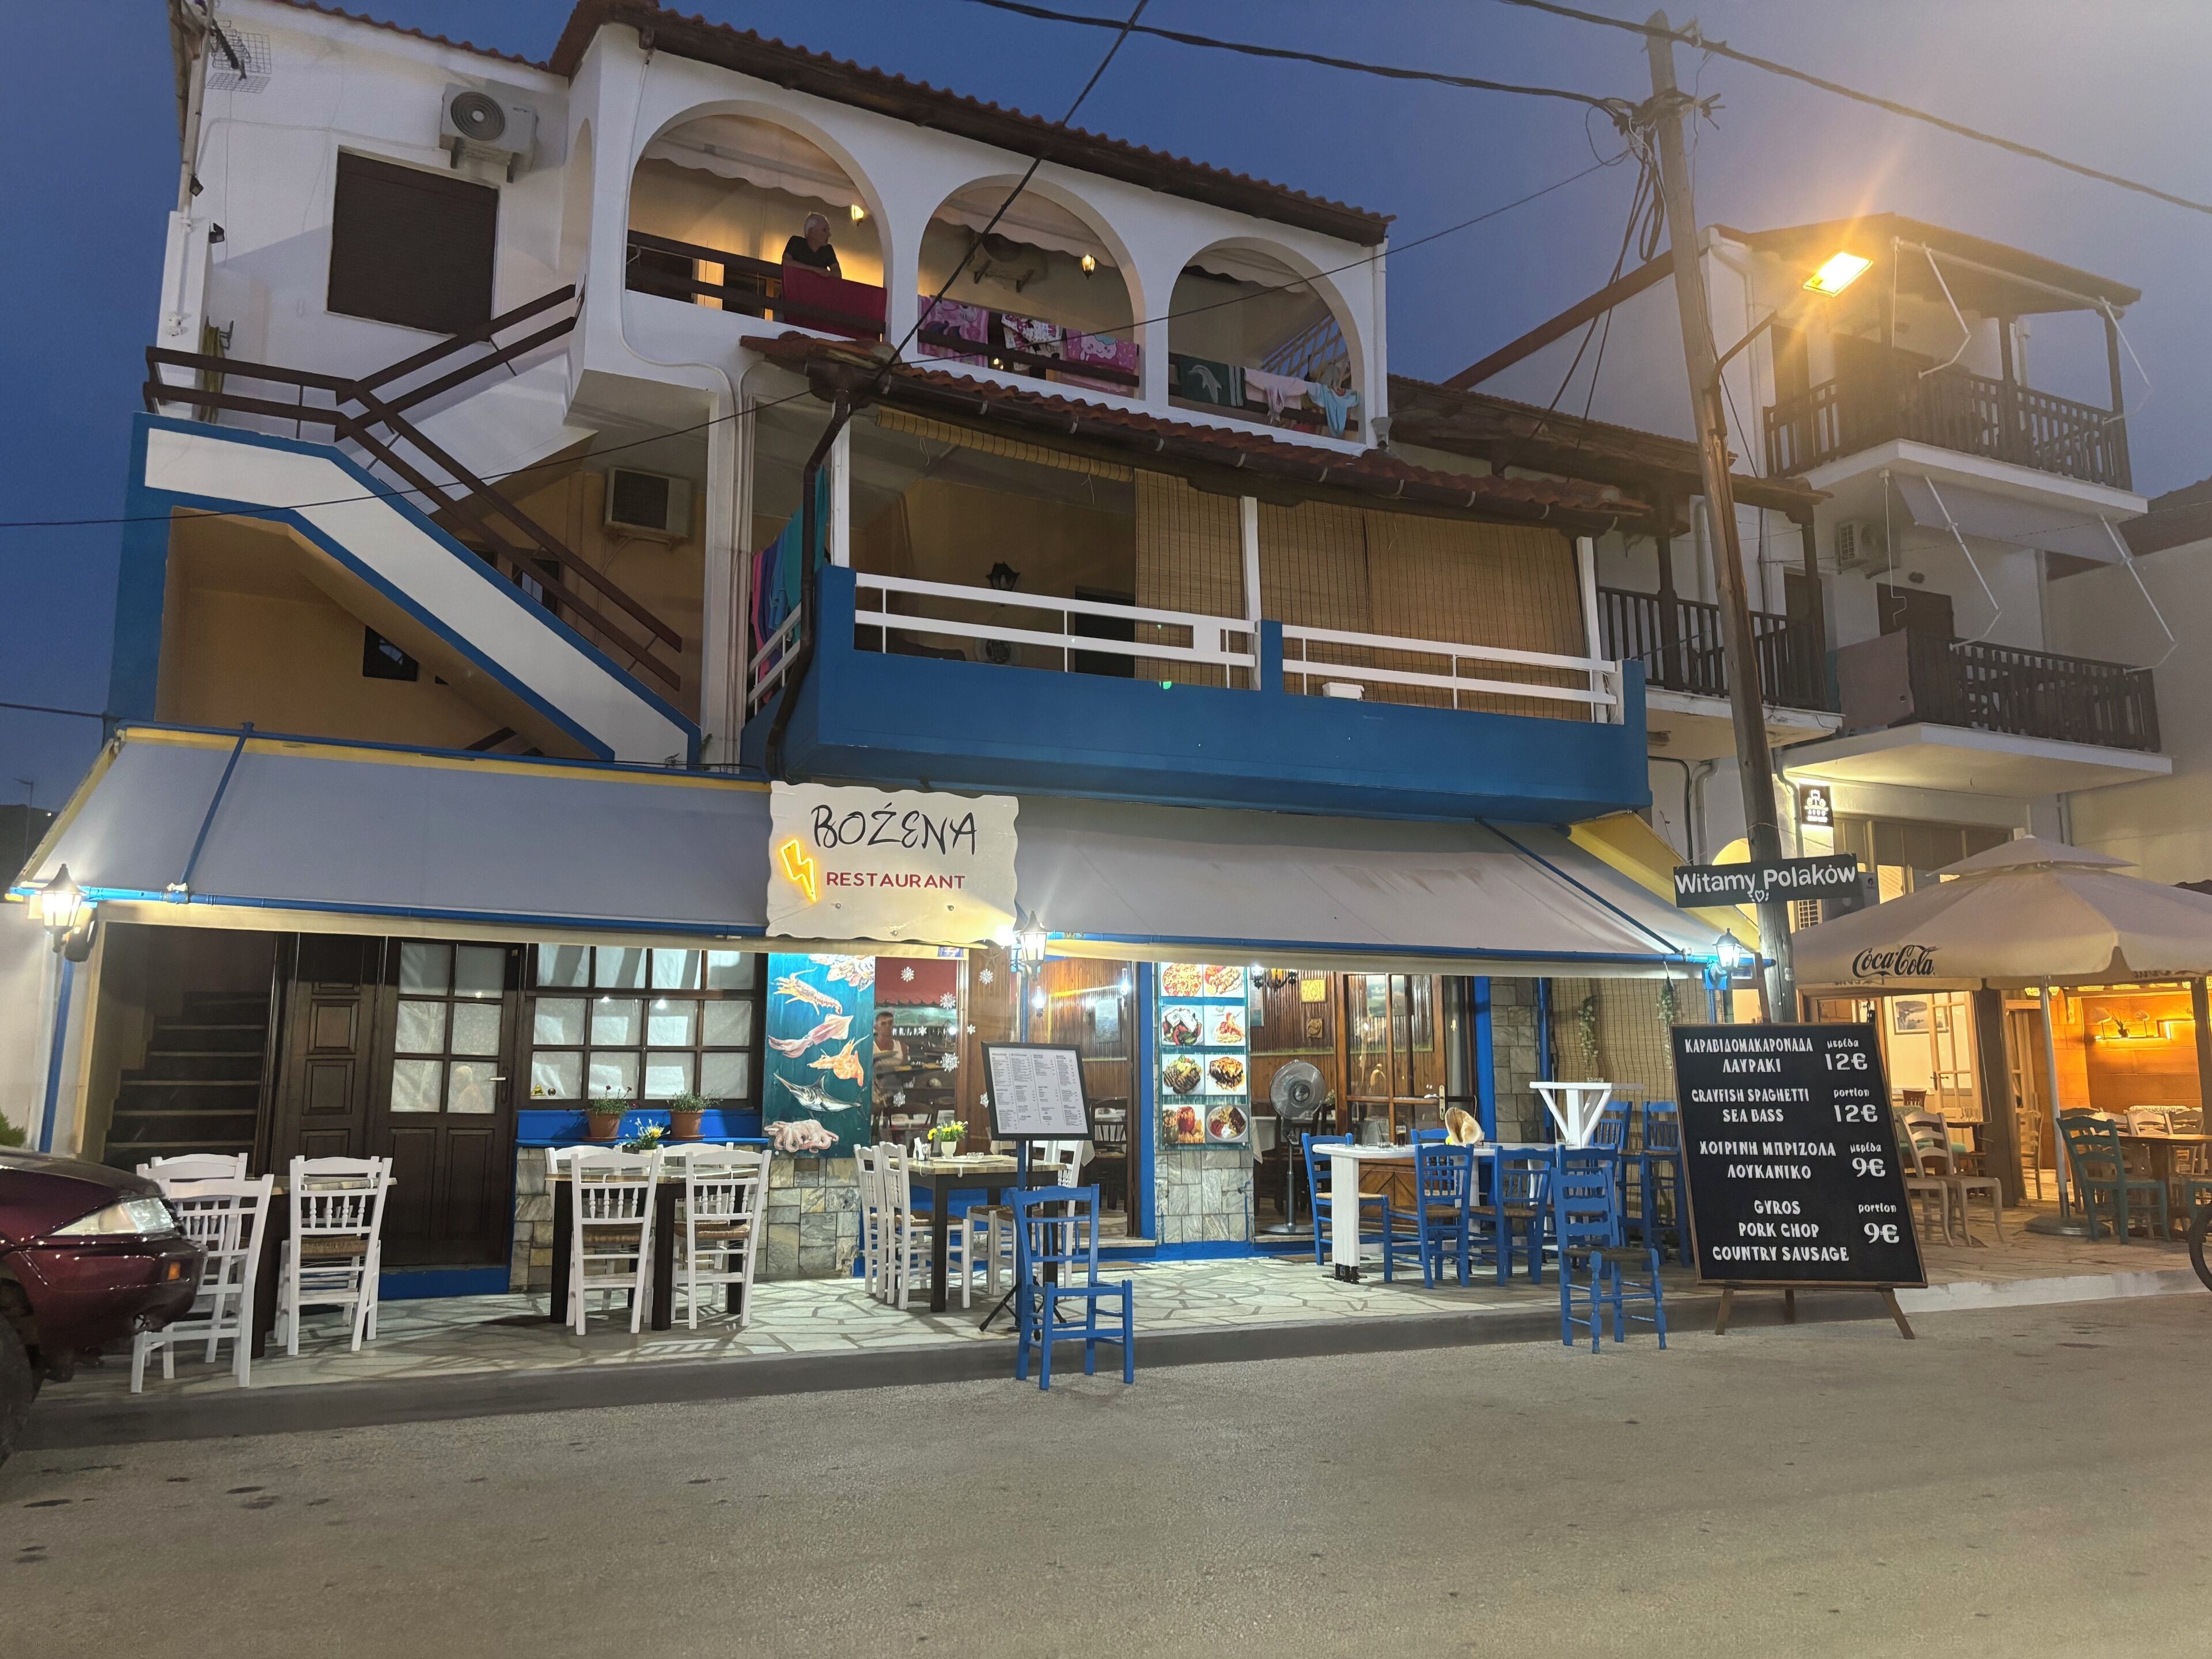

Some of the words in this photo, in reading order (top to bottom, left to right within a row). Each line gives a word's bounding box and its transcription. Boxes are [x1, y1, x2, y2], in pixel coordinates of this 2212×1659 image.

[826, 872, 966, 889] RESTAURANT
[1674, 873, 1756, 895] Witamy
[1763, 863, 1855, 891] Polaków
[1722, 1058, 1781, 1073] ΛΑΥΡΑΚΙ
[1824, 1052, 1868, 1071] 12€
[1691, 1089, 1745, 1103] CRAYFISH
[1747, 1088, 1809, 1103] SPAGHETTI
[1834, 1087, 1870, 1099] portion
[1722, 1108, 1748, 1122] SEA
[1751, 1108, 1784, 1122] BASS
[1834, 1104, 1878, 1123] 12€
[1699, 1141, 1759, 1156] ΧΟΙΡΙΝΗ
[1762, 1142, 1836, 1156] ΜΠΡΙΖΟΛΑ
[1727, 1164, 1812, 1179] ΛΟΥΚΑΝΙΚΟ
[1852, 1157, 1887, 1178] 9€
[1754, 1199, 1801, 1215] GYROS
[1858, 1202, 1897, 1214] portion
[1738, 1222, 1777, 1237] PORK
[1781, 1223, 1819, 1238] CHOP
[1863, 1222, 1900, 1244] 9€
[1712, 1246, 1777, 1261] COUNTRY
[1782, 1246, 1849, 1262] SAUSAGE
